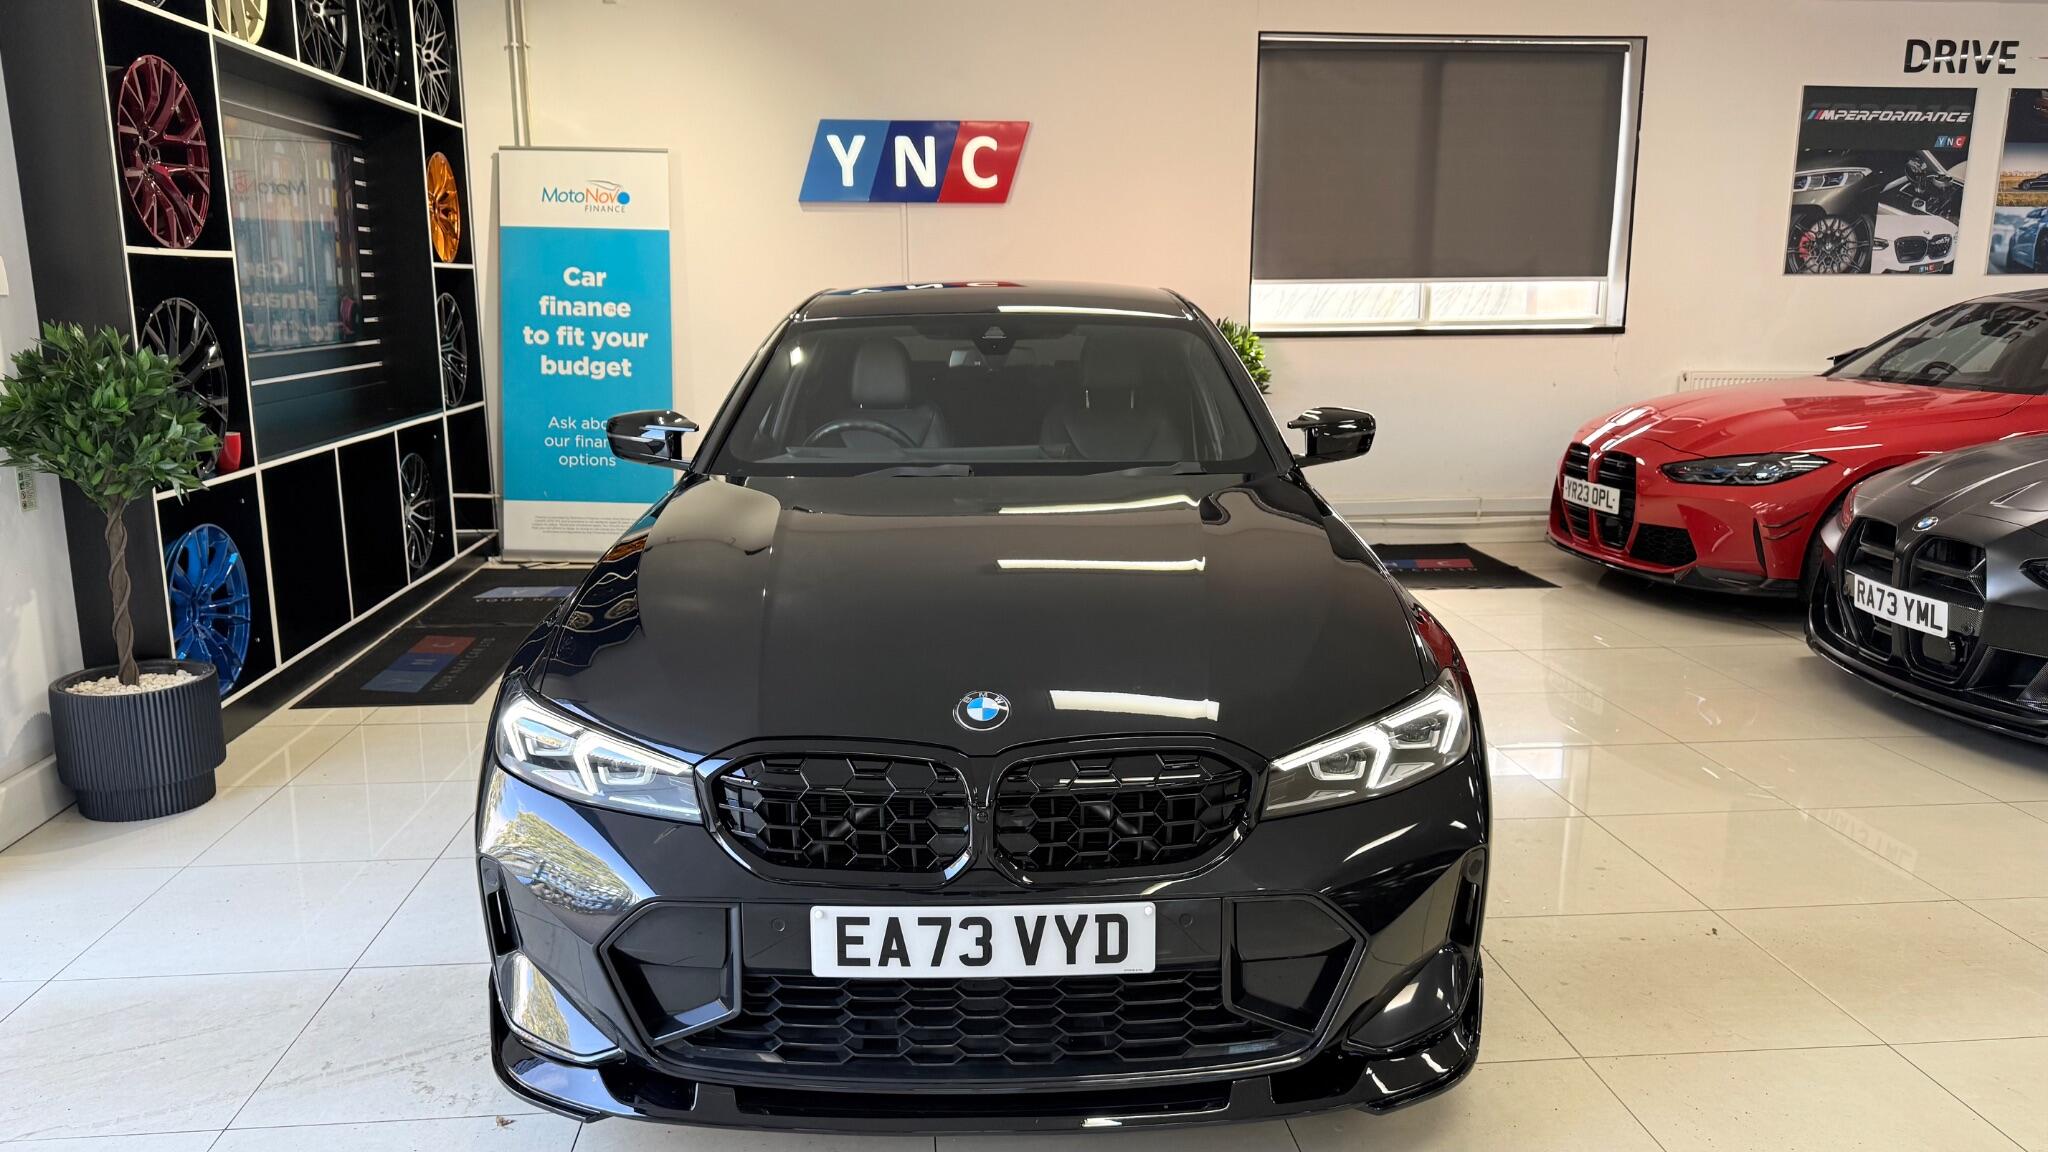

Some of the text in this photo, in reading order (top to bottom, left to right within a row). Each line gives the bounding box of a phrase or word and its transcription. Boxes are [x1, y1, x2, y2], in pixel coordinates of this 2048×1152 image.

[1903, 39, 2019, 74] DRIVE
[1937, 137, 1964, 147] YNC
[826, 135, 998, 189] YNC
[584, 205, 625, 213] FINANCE
[563, 267, 607, 287] Car
[539, 295, 631, 318] finance
[523, 326, 649, 350] to fit your
[540, 355, 632, 380] budget
[548, 416, 608, 430] Ask abo
[544, 436, 570, 447] our
[558, 453, 617, 468] options
[1566, 479, 1613, 509] YR23 OPL
[1856, 580, 1943, 632] RA73 YML
[835, 914, 1129, 967] EA73 VYD
